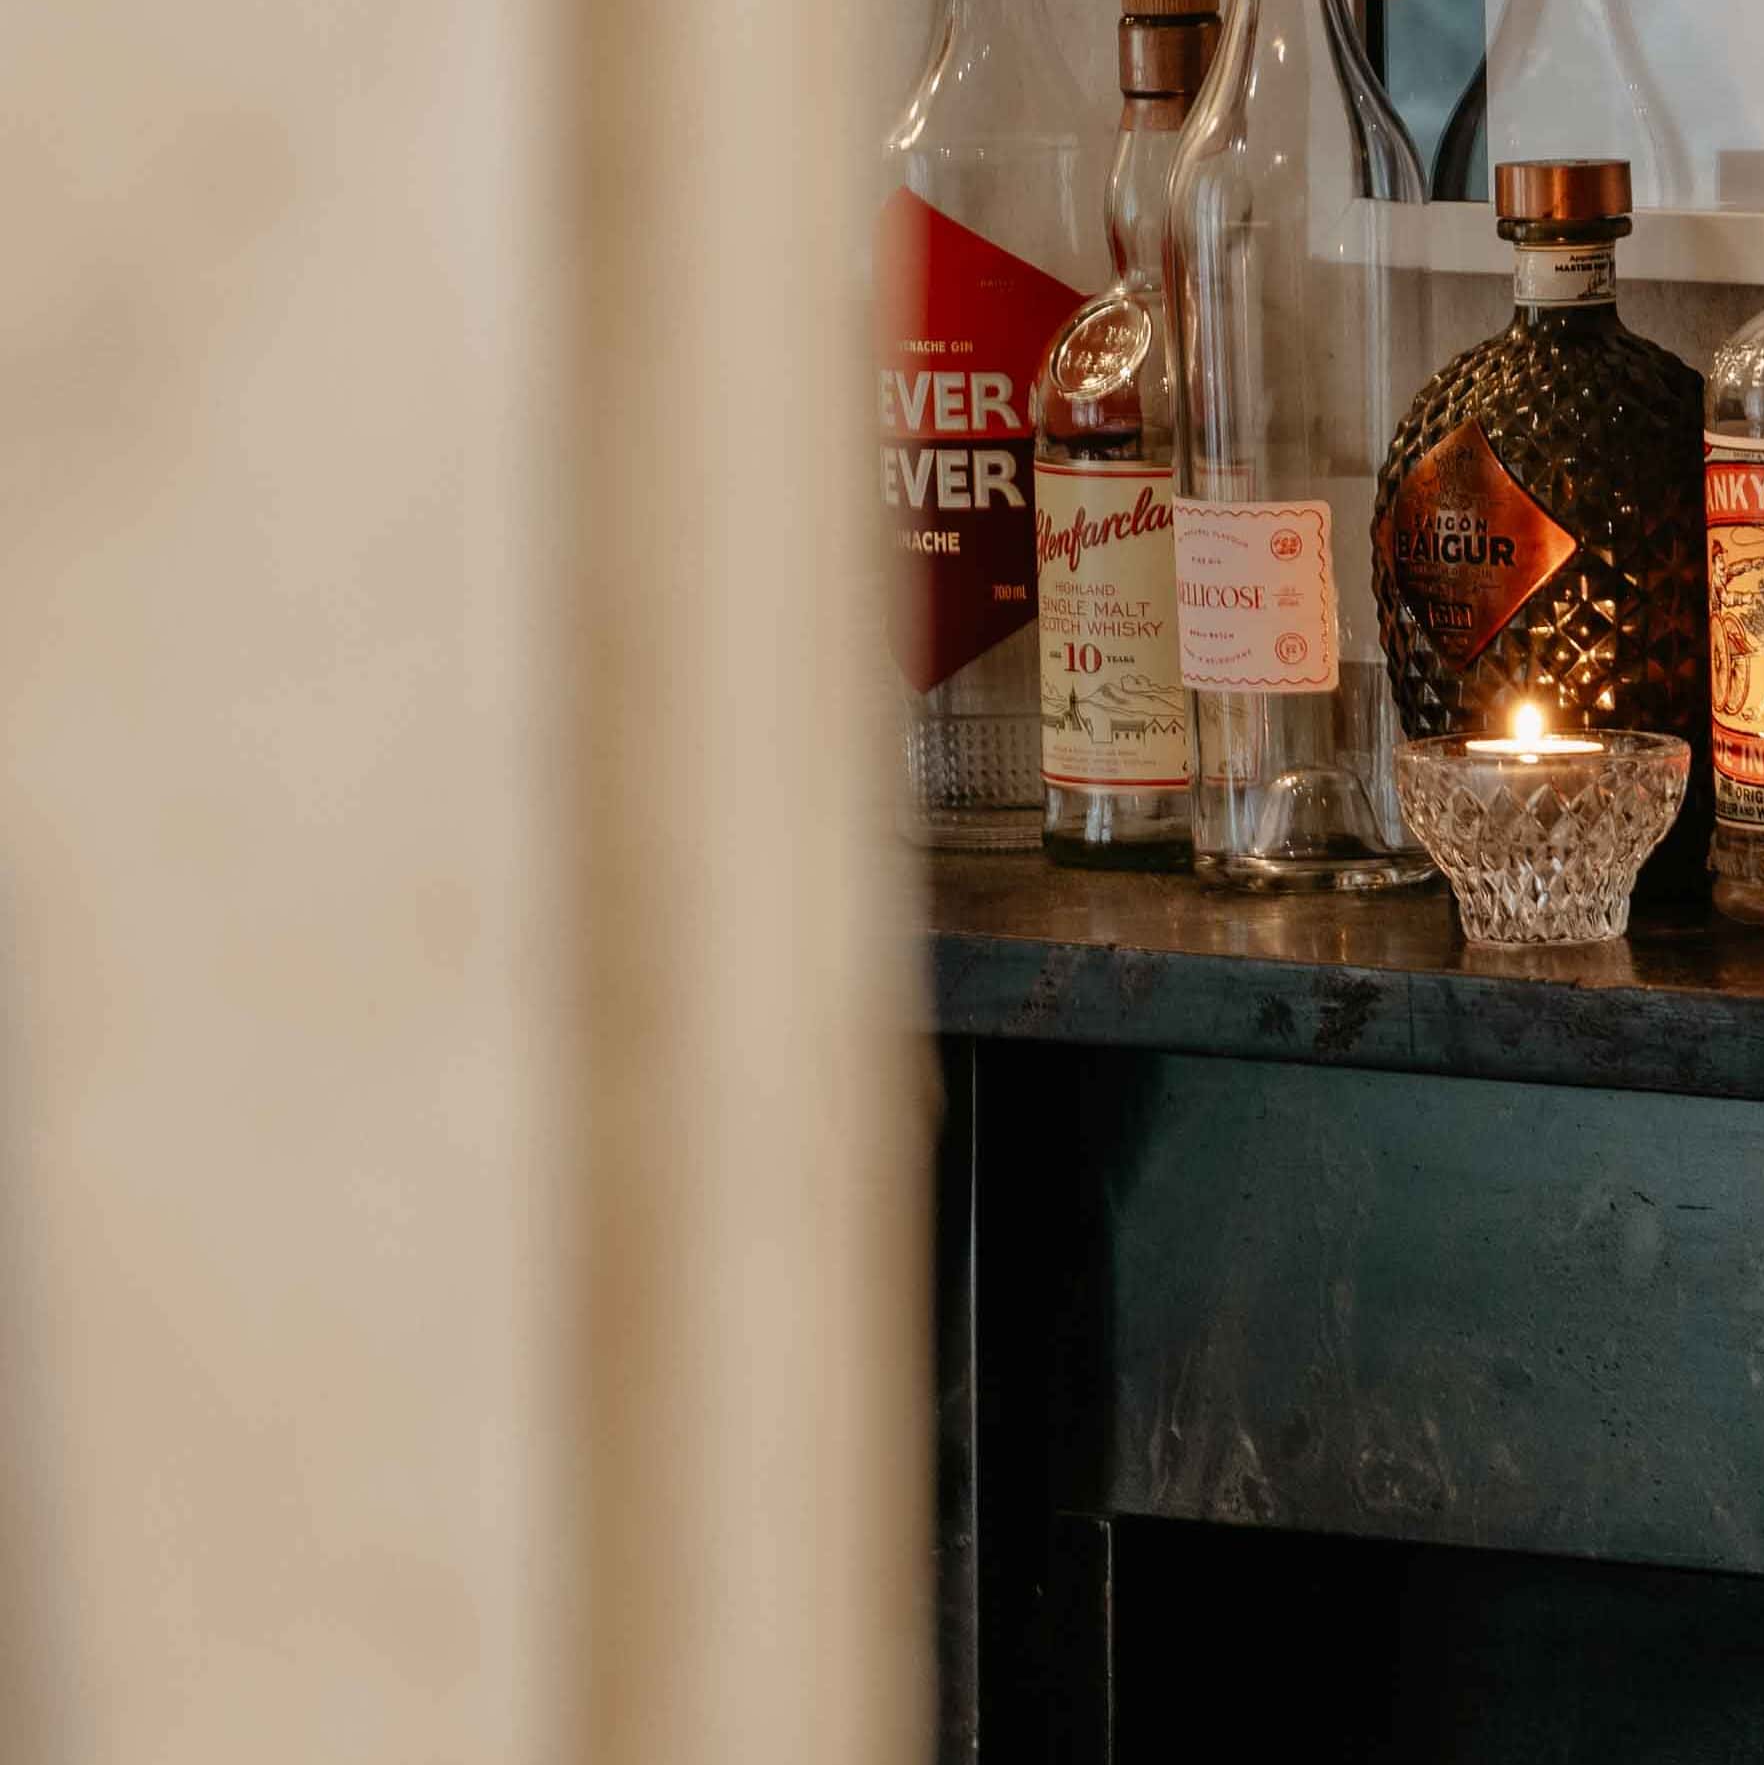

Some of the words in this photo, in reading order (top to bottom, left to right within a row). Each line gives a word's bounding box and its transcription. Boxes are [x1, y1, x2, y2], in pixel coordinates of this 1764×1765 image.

[950, 339, 974, 354] GIN
[1037, 486, 1174, 574] Glenfarcla
[1399, 531, 1516, 567] BAIGUR
[1055, 581, 1116, 596] HIGHLAND
[1041, 595, 1088, 616] SINGLE
[1094, 601, 1151, 618] MALT
[1040, 613, 1081, 635] SCOTCH
[1088, 621, 1164, 637] WHISKY
[1064, 641, 1102, 674] 10
[1106, 655, 1136, 664] YEARS
[1741, 743, 1764, 776] IN
